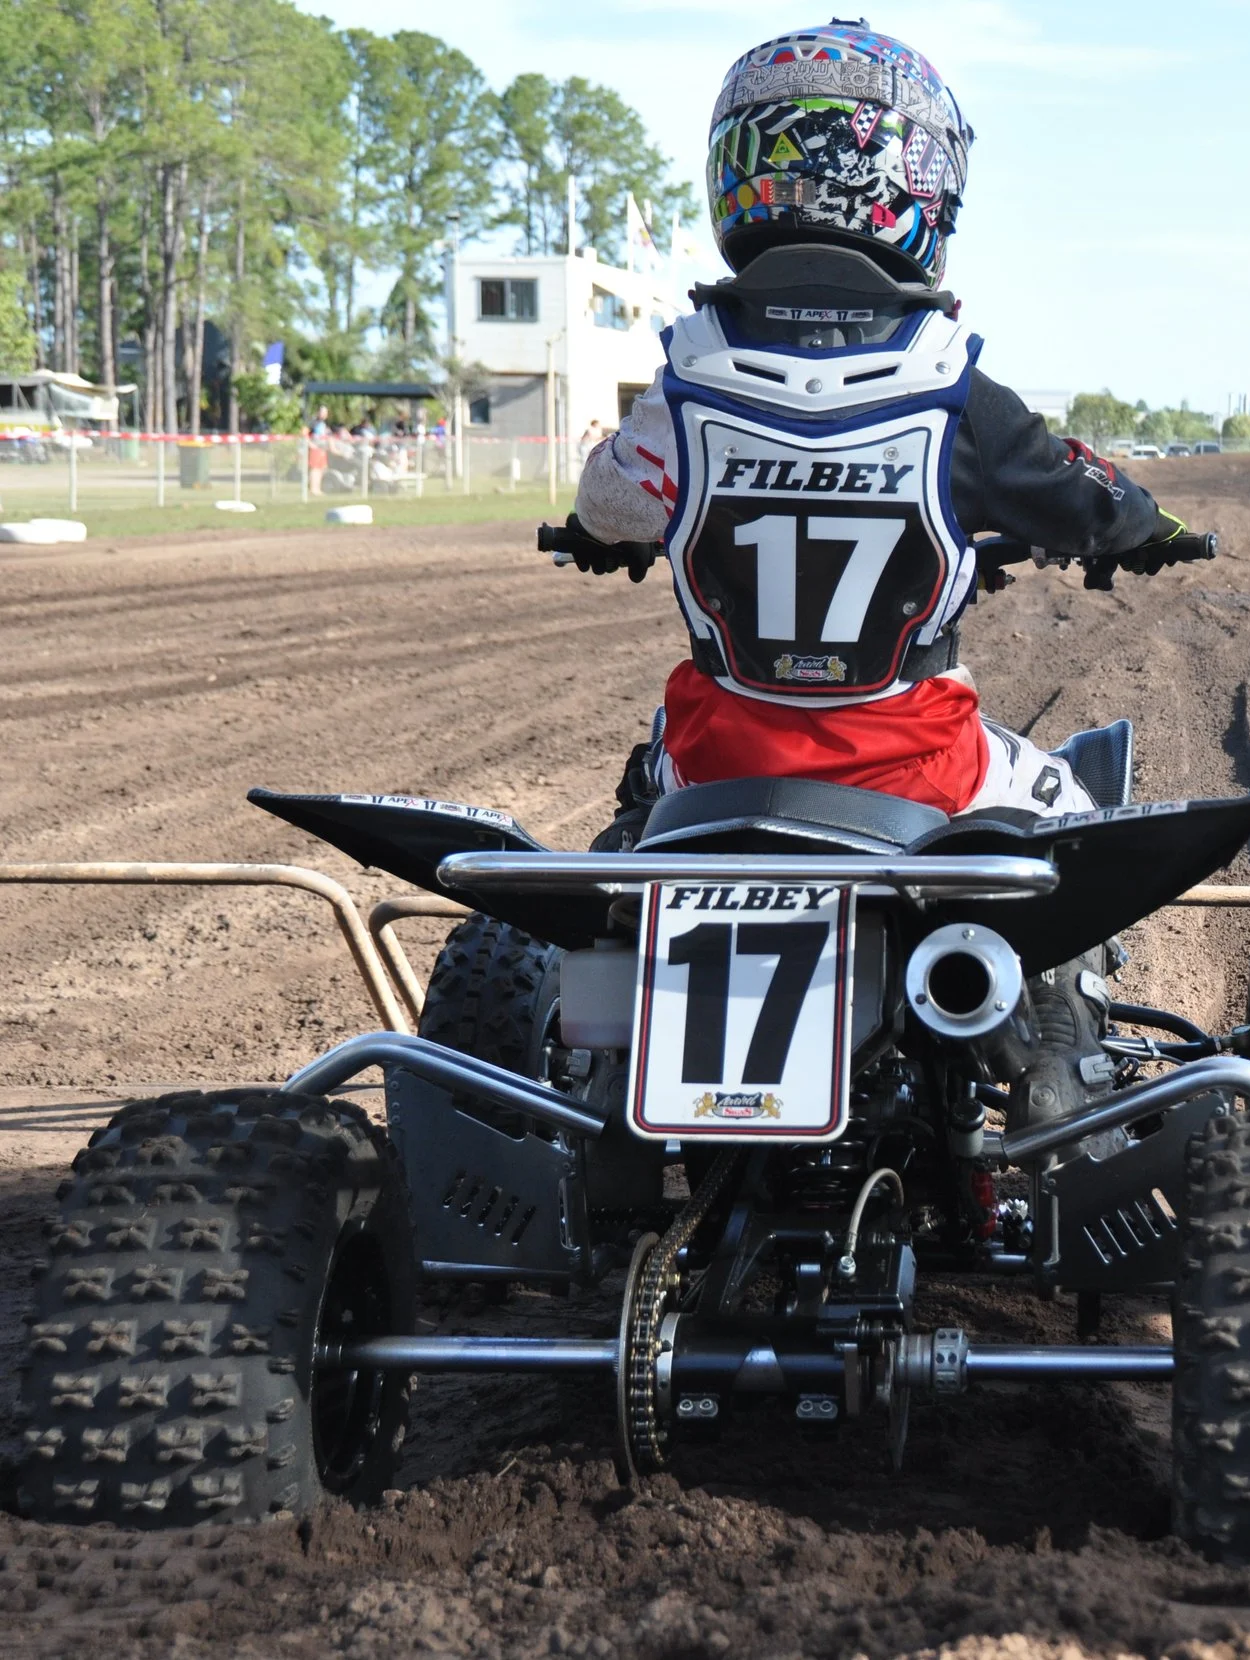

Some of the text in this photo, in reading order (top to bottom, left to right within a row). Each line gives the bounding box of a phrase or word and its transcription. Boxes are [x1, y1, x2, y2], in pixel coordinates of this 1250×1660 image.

[790, 309, 802, 319] 17
[805, 310, 832, 320] APEX
[836, 311, 848, 321] 17
[716, 458, 914, 494] FILBEY
[734, 514, 906, 643] 17
[371, 795, 384, 804] 17
[388, 797, 419, 808] APEX
[424, 800, 437, 810] 17
[466, 807, 479, 817] 17
[665, 886, 834, 910] FILBEY
[667, 921, 830, 1085] 17
